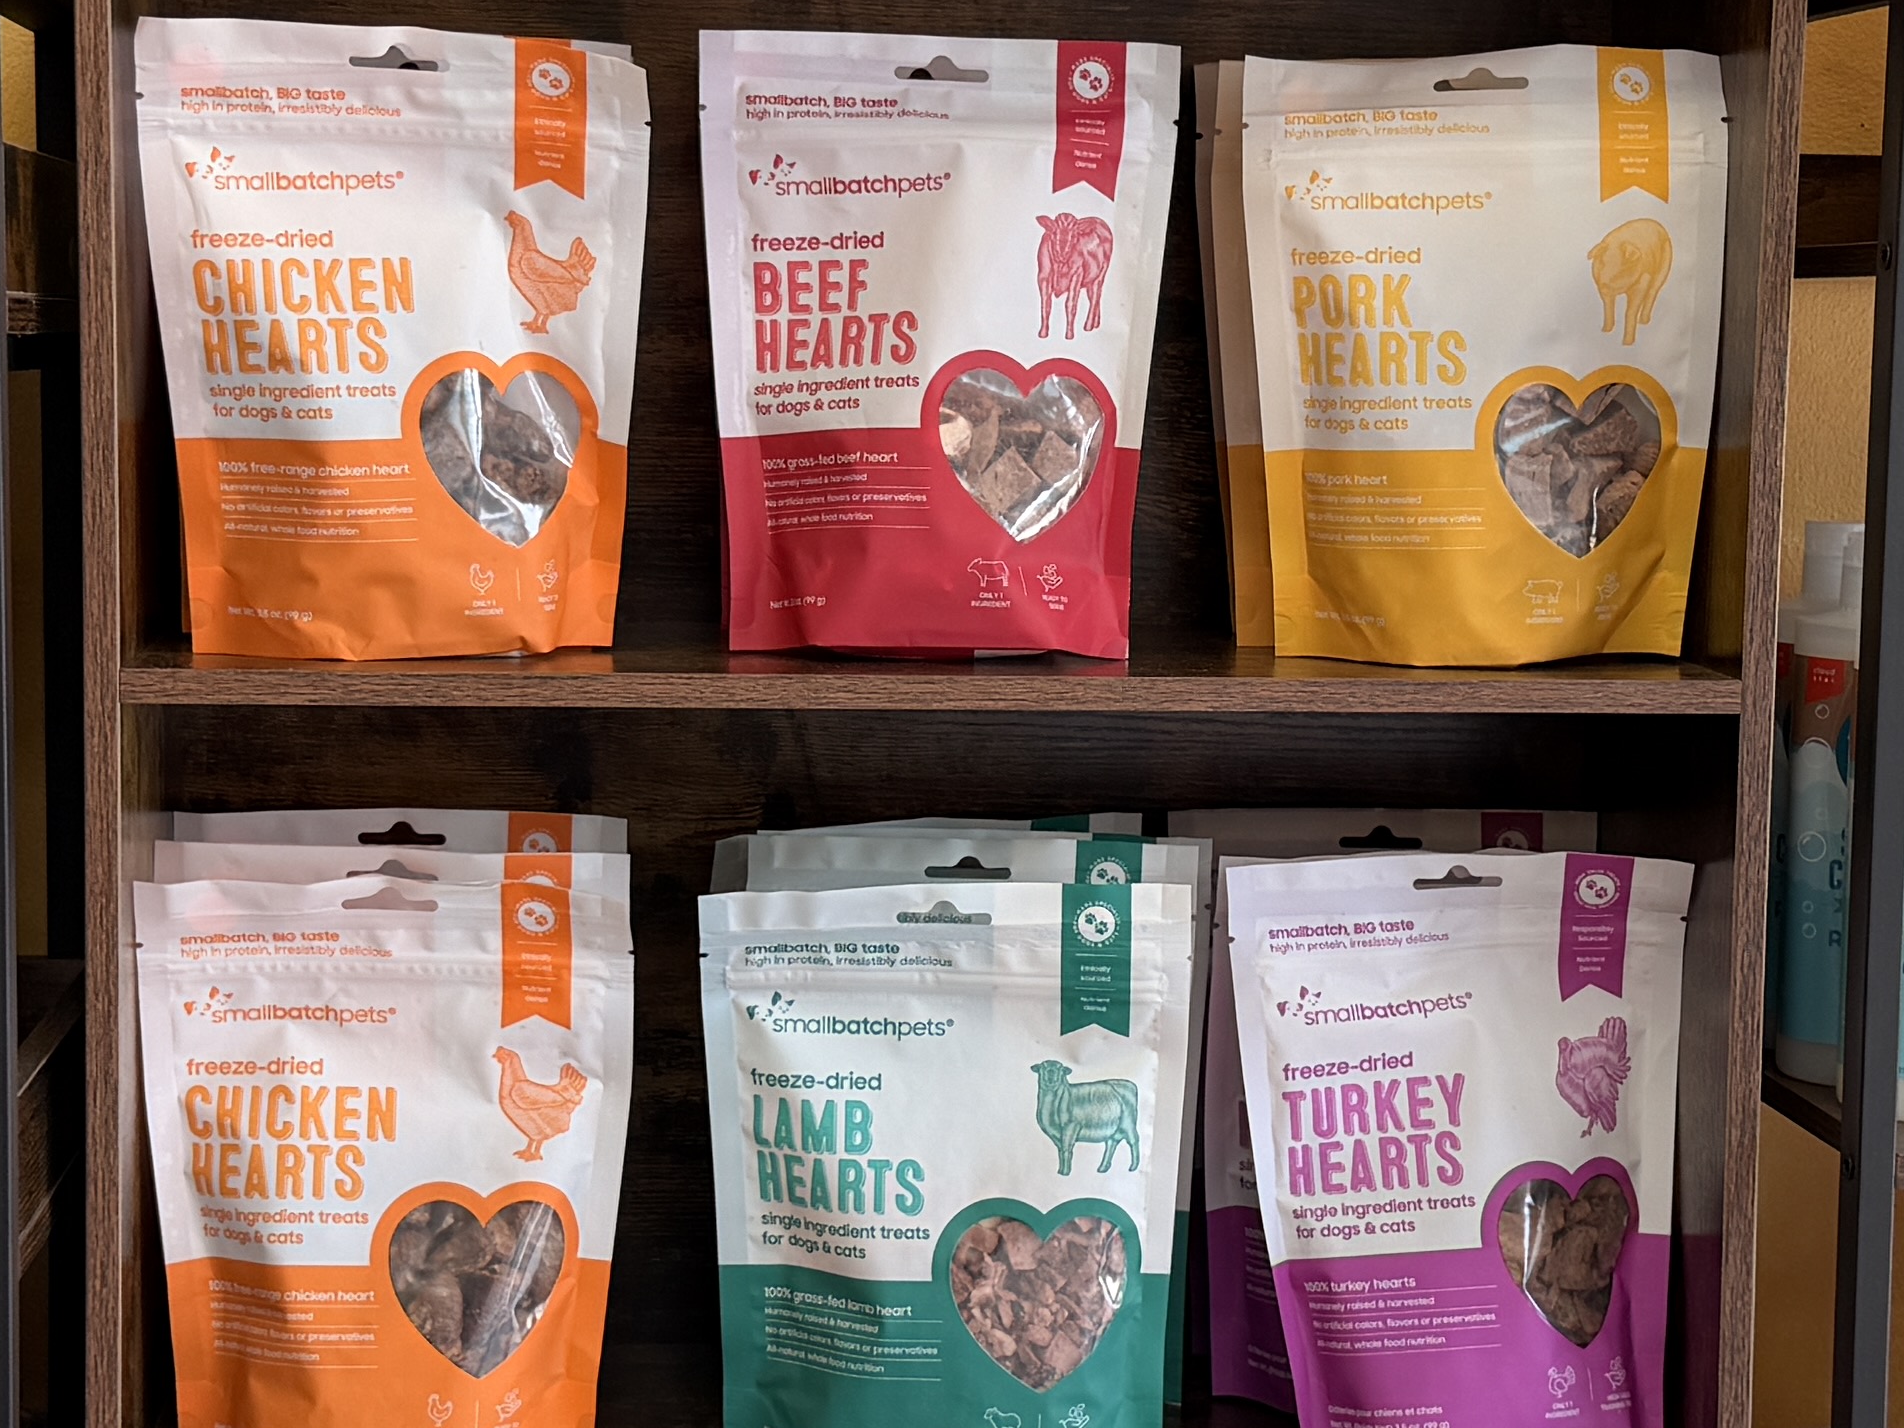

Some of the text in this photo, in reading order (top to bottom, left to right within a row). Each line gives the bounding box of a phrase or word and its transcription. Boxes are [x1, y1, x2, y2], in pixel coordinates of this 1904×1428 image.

[276, 87, 301, 100] BIG
[305, 88, 345, 100] taste
[191, 229, 333, 249] freeze-dried
[751, 232, 884, 251] freeze-dried
[193, 257, 414, 314] CHICKEN
[753, 259, 868, 315] BEEF
[1292, 273, 1412, 329] PORK
[201, 318, 393, 375] HEARTS
[754, 311, 918, 374] HEARTS
[1297, 330, 1467, 388] HEARTS
[209, 382, 396, 400] single ingredient treats
[213, 403, 333, 423] for dogs & cats
[318, 463, 409, 477] chicken heart
[184, 1085, 397, 1143] CHICKEN
[754, 1095, 872, 1156] LAMB
[1282, 1072, 1464, 1141] TURKEY
[192, 1145, 365, 1201] HEARTS
[758, 1156, 924, 1219] HEARTS
[1286, 1130, 1464, 1199] HEARTS
